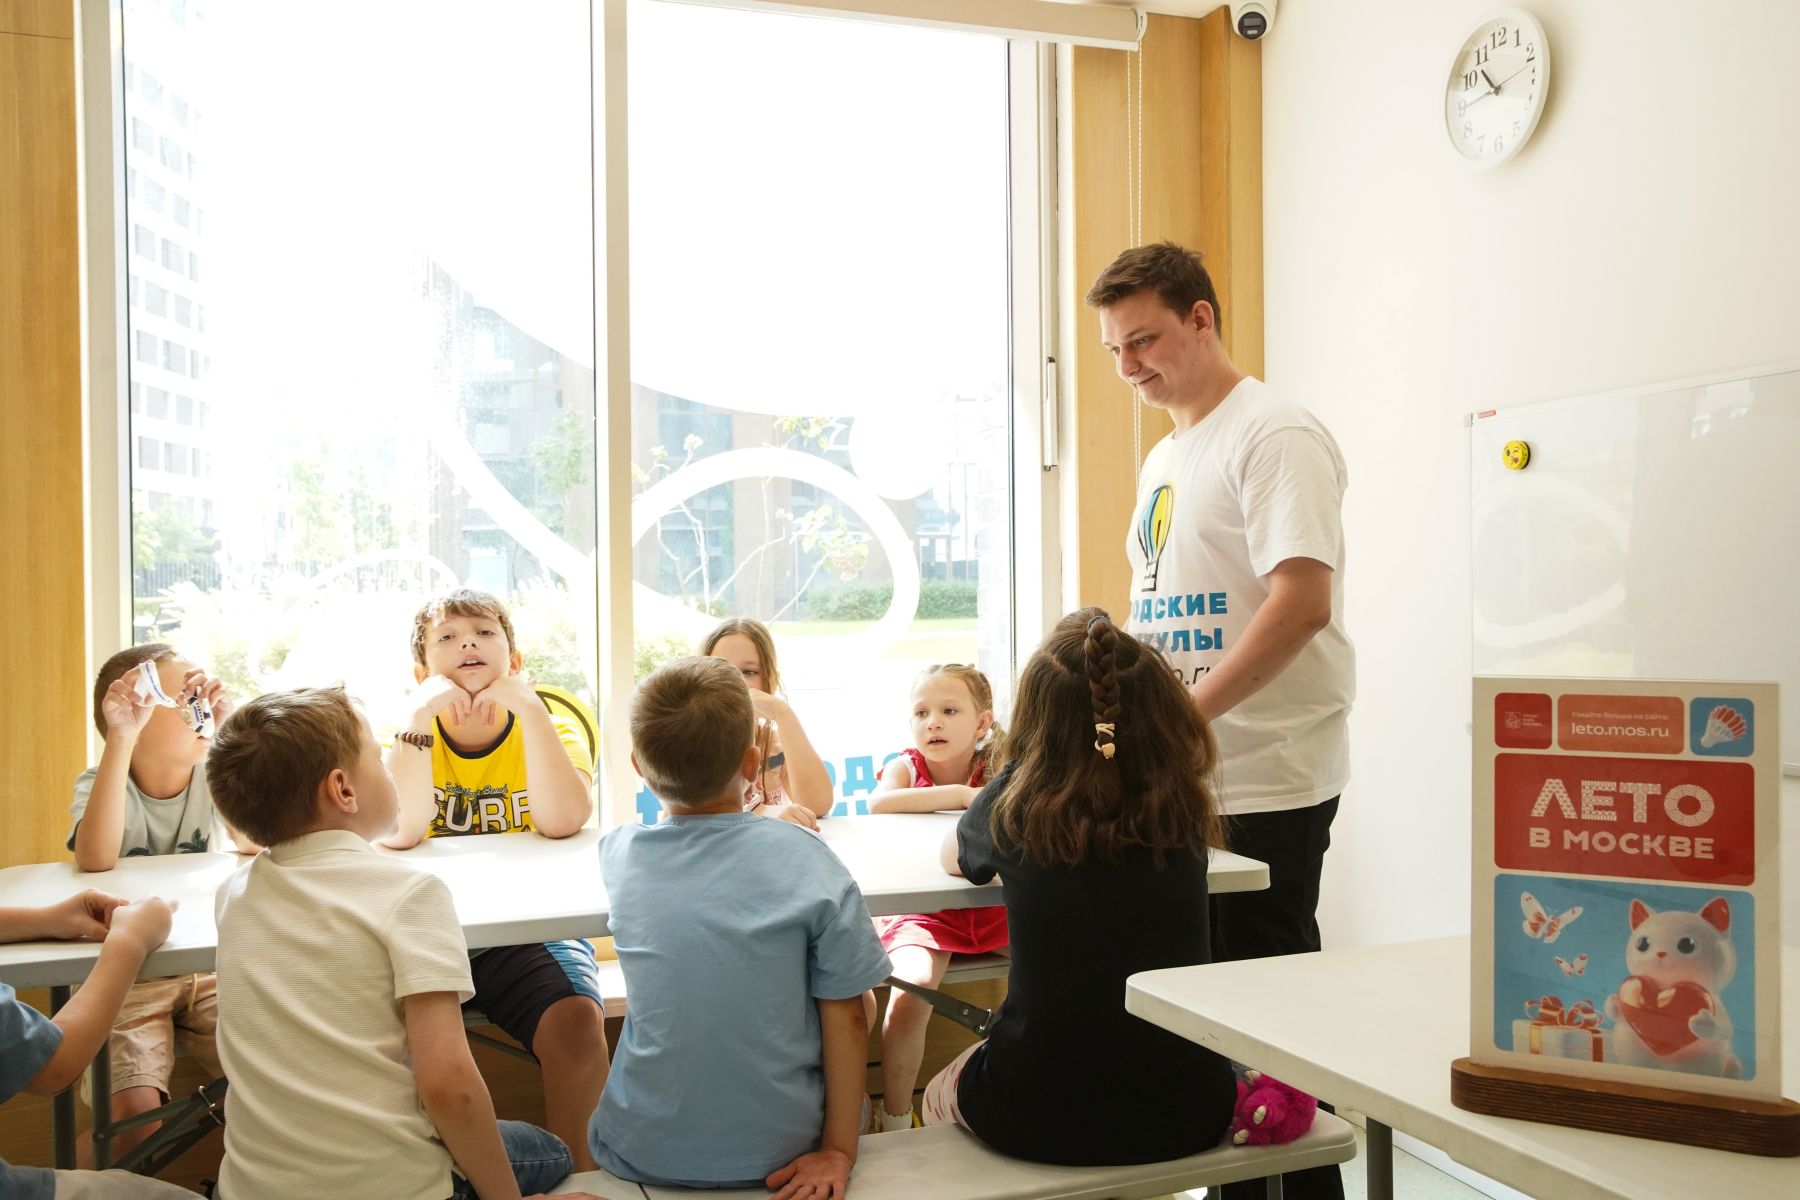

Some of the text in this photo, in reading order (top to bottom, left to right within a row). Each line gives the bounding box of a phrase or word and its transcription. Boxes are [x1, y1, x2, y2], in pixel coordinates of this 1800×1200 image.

[1489, 26, 1507, 50] 12
[1514, 28, 1521, 48] 1
[1474, 44, 1490, 66] 11
[1526, 42, 1535, 63] 2
[1463, 69, 1478, 92] 10
[1458, 99, 1467, 117] 9
[1463, 120, 1472, 139] 8
[1494, 134, 1503, 153] 6
[1571, 722, 1669, 737] leto.mos.ru
[1530, 778, 1715, 827] ЛЕТО
[1529, 827, 1715, 859] В МОСКВЕ
